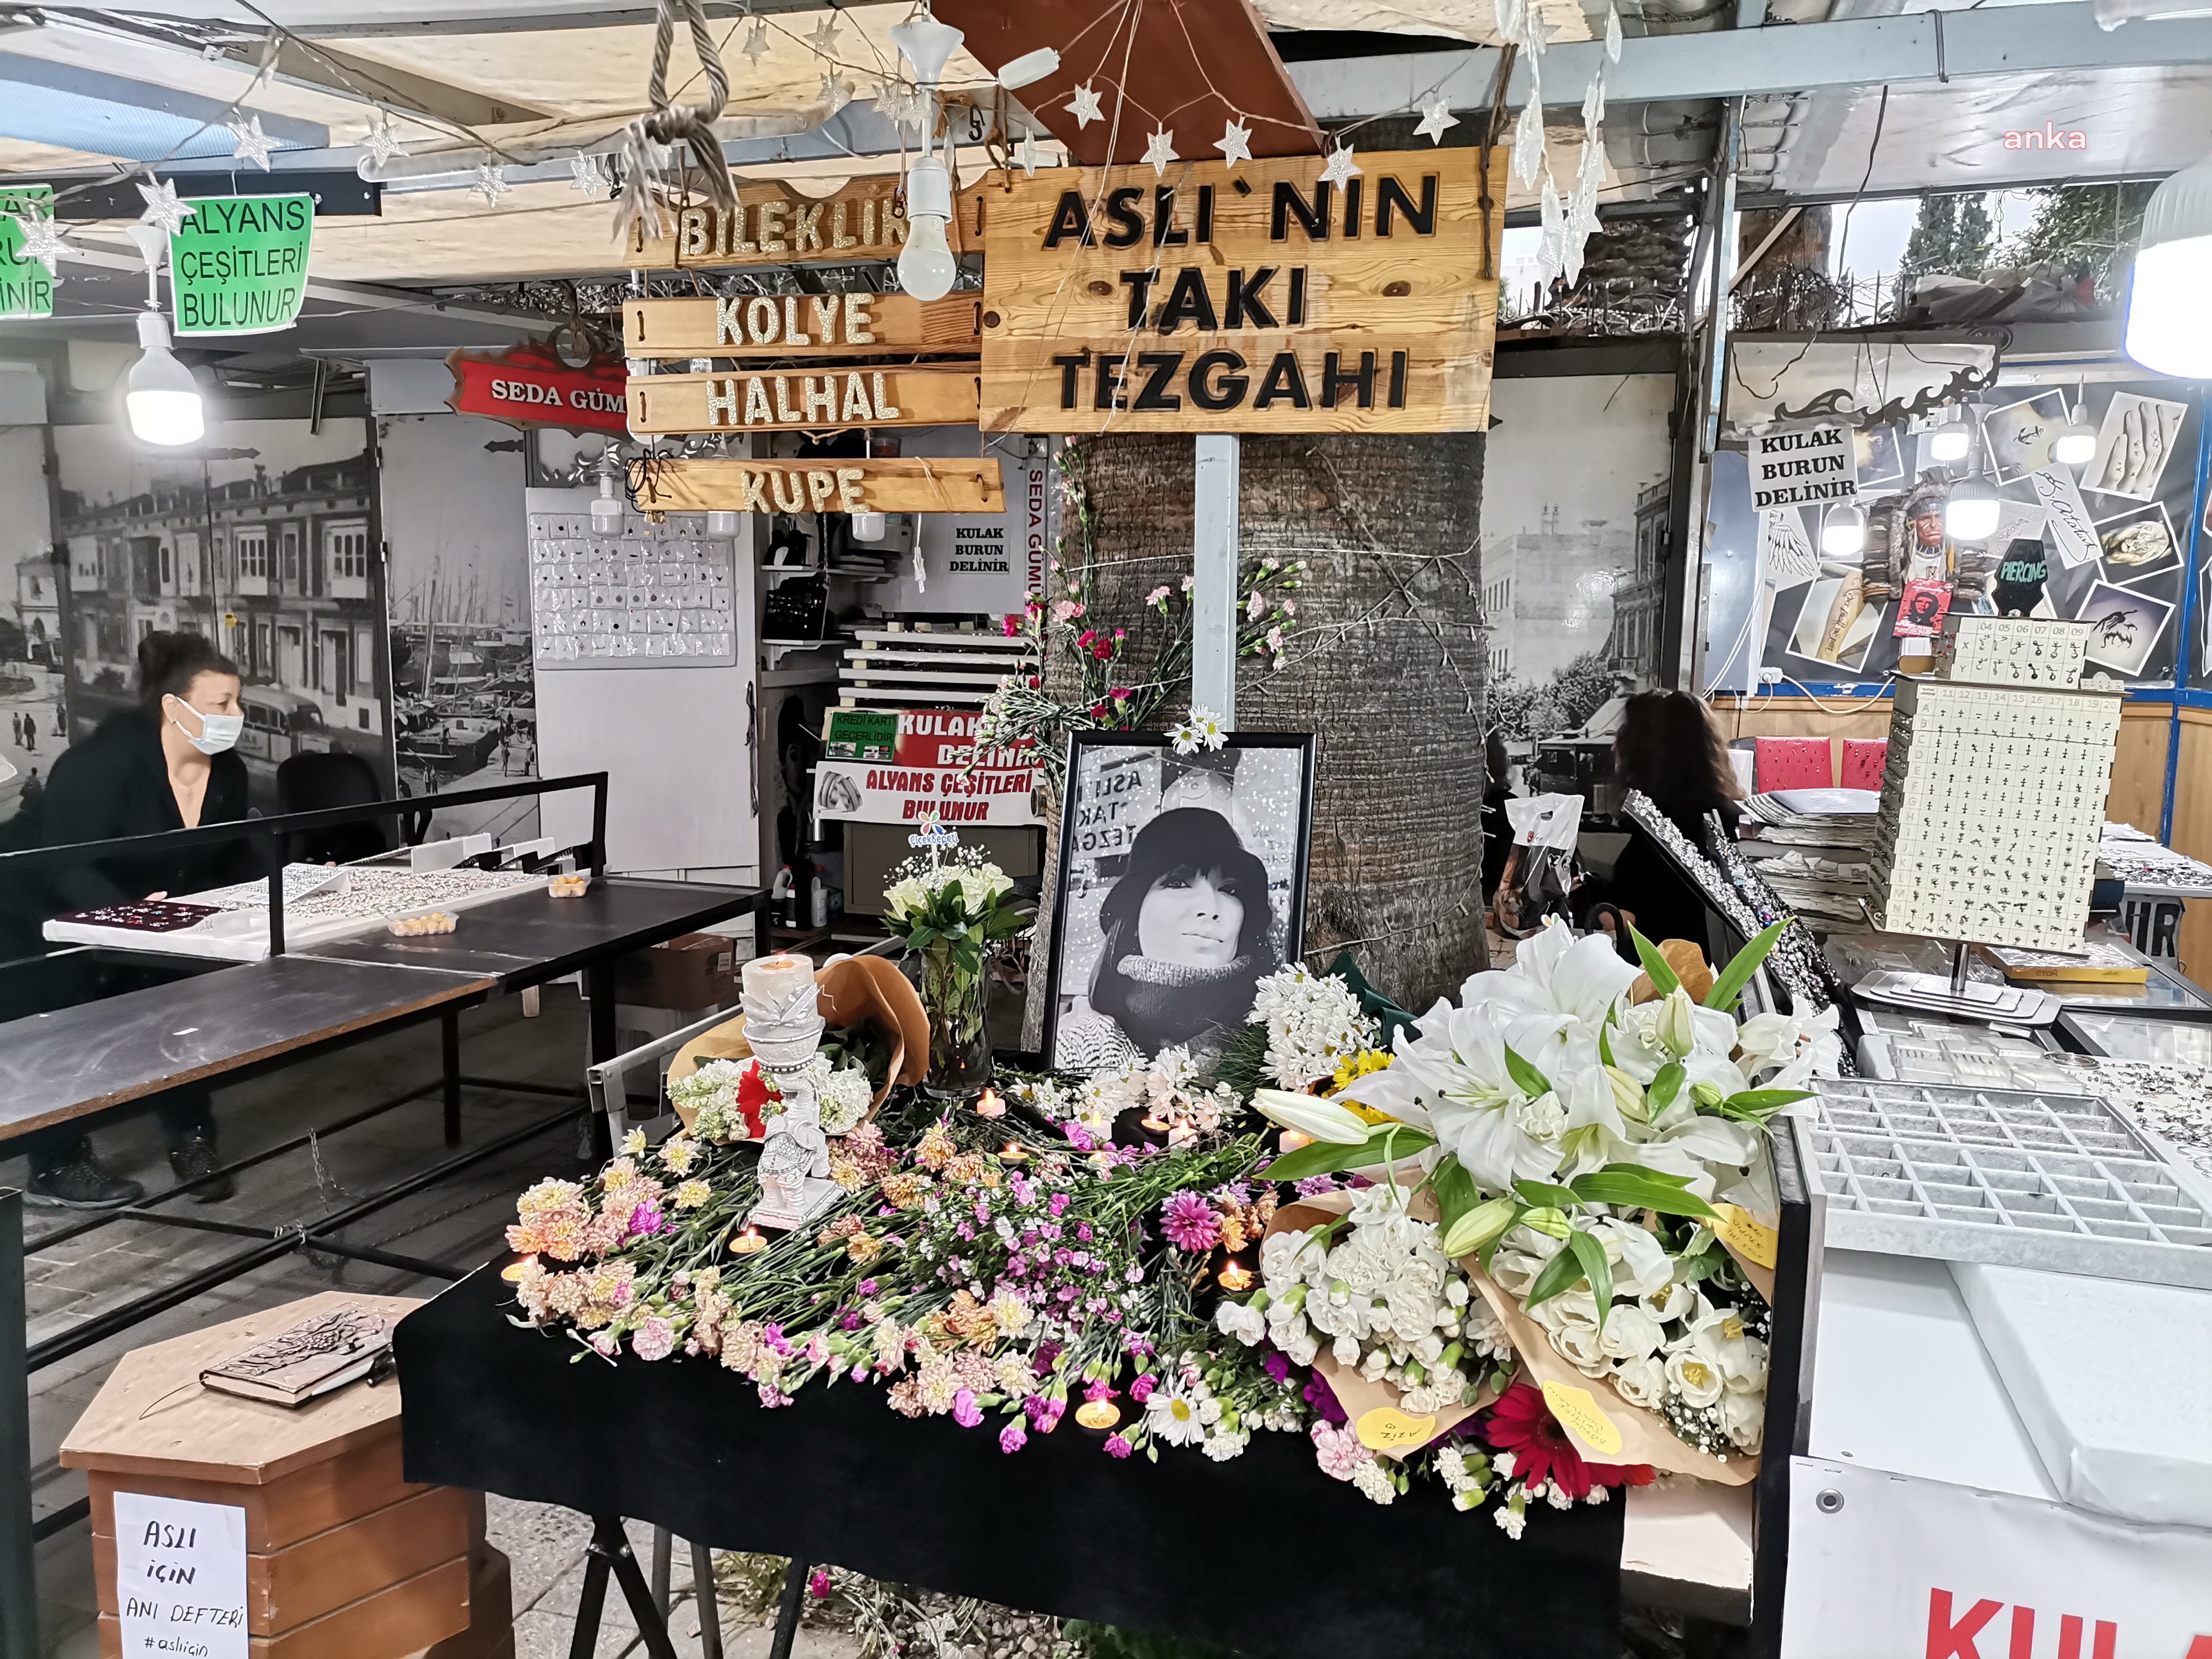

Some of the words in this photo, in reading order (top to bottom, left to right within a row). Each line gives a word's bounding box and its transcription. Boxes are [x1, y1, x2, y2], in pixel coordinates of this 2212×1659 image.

[180, 200, 305, 234] ALYANS
[181, 241, 302, 286] ÇEŞİTLERİ
[184, 288, 295, 326] BULUNUR
[1120, 264, 1308, 331] TAKI
[717, 293, 876, 346] KOLYE
[492, 379, 563, 406] SEDA
[1053, 347, 1409, 413] TEZGAHI
[707, 372, 901, 425] HALHAL
[1761, 429, 1843, 453] KULAK
[1761, 455, 1845, 480] BURUN
[740, 467, 870, 514] KUPE
[1029, 469, 1043, 528] SEDA
[1755, 477, 1858, 507] DELİNİR
[956, 528, 1004, 539] KULAK
[950, 558, 1009, 571] DELİNİR
[955, 545, 1004, 555] BURUN
[1027, 534, 1044, 604] GÜMÜ
[2000, 560, 2047, 583] PIERCING
[2016, 625, 2030, 633] 06
[2034, 625, 2047, 634] 07
[2053, 627, 2065, 635] 08
[866, 769, 935, 792] ALYANS
[941, 770, 1032, 798] ÇEŞİTLERİ
[902, 800, 989, 820] BULUNUR
[143, 1520, 196, 1548] ASLI
[127, 1598, 158, 1619] ANI
[170, 1604, 244, 1629] DEFTERİ
